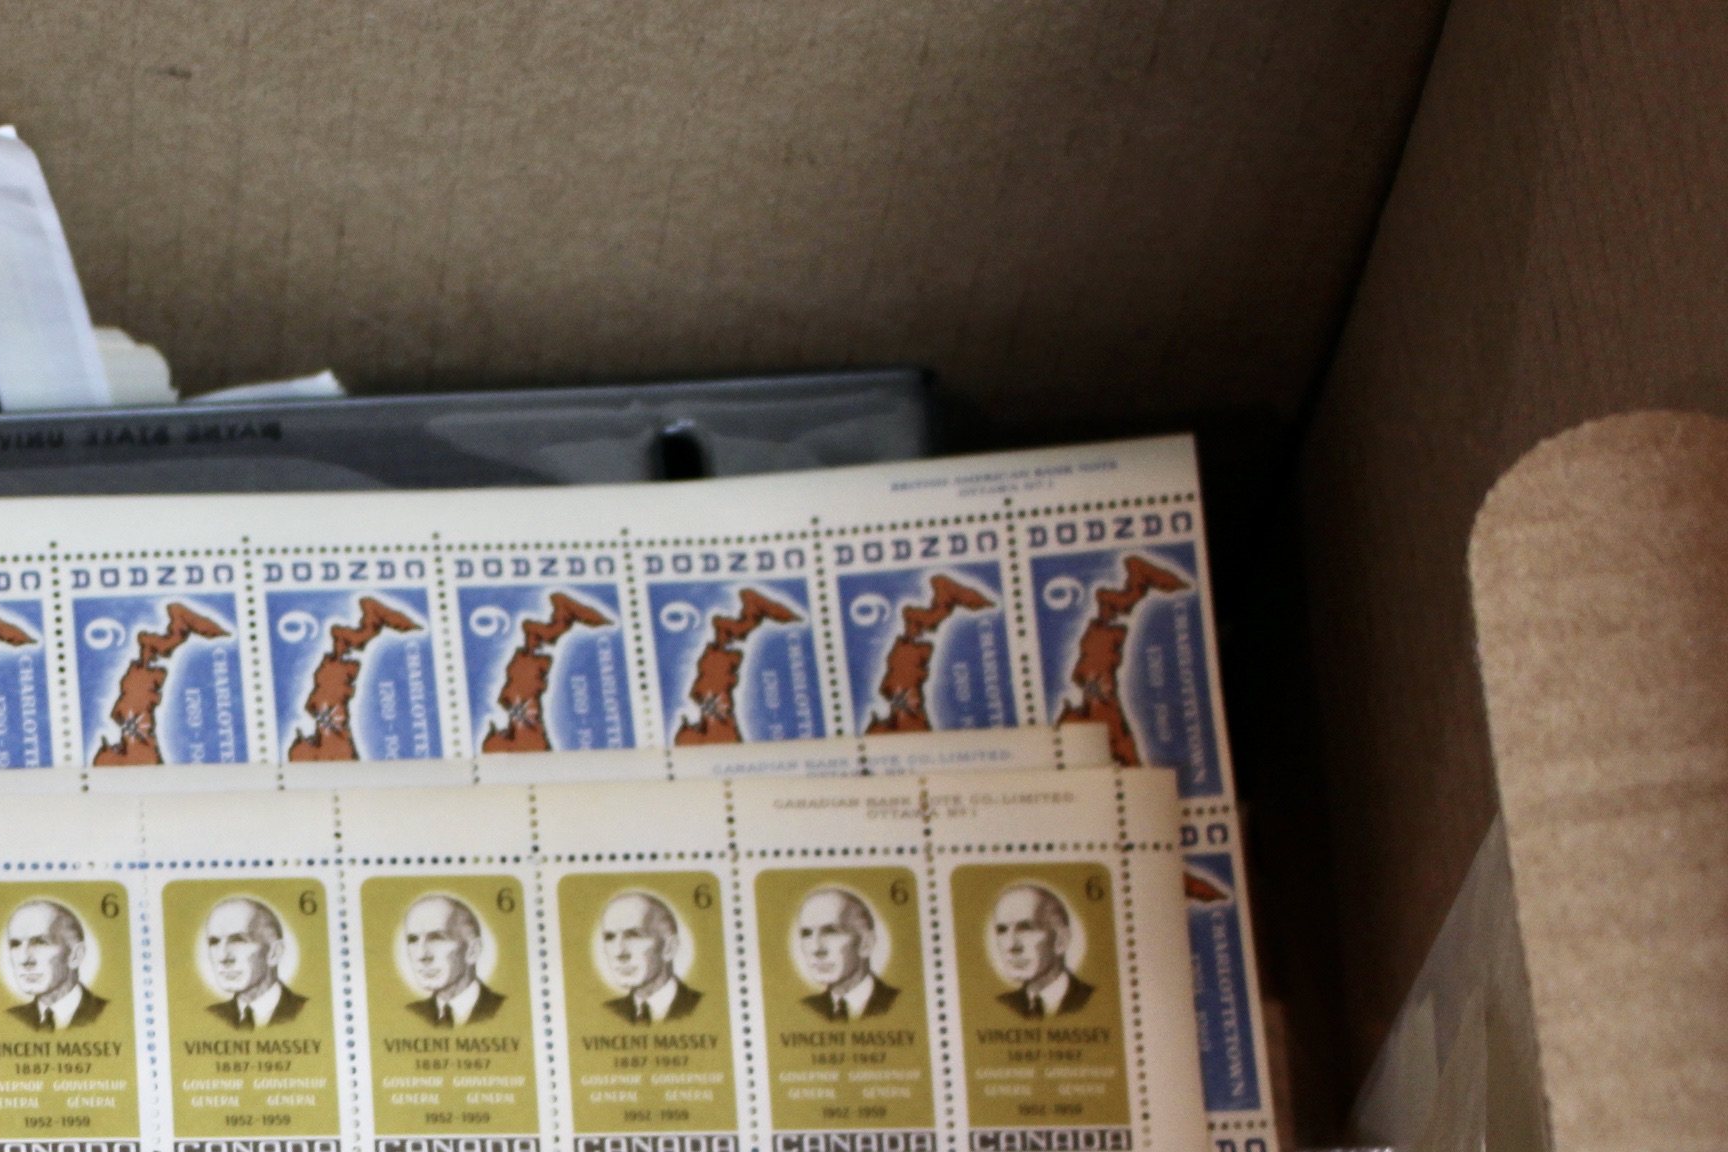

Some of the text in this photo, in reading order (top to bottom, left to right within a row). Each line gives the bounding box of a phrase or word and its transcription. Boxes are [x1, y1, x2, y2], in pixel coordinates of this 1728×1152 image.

[1027, 511, 1193, 548] CANADA
[834, 531, 999, 566] CANADA
[262, 559, 427, 582] CANADA
[453, 555, 617, 578] CANADA
[643, 551, 806, 574] CANADA
[70, 564, 235, 589] CANADA
[1042, 574, 1086, 611] 6
[468, 606, 511, 637] 6
[659, 601, 702, 632] 6
[849, 592, 892, 627] 6
[83, 617, 126, 649] 6
[276, 610, 319, 642] 6
[297, 890, 318, 916] 6
[495, 888, 515, 914] 6
[692, 885, 712, 911] 6
[888, 881, 909, 907] 6
[1083, 877, 1103, 903] 6
[99, 893, 119, 919] 6
[184, 1039, 322, 1056] VINCENT MASSEY
[384, 1037, 520, 1054] VINCENT MASSEY
[582, 1034, 718, 1052] VINCENT MASSEY
[780, 1031, 916, 1049] VINCENT MASSEY
[977, 1027, 1111, 1045] VINCENT MASSEY
[55, 1041, 122, 1058] MASSEY
